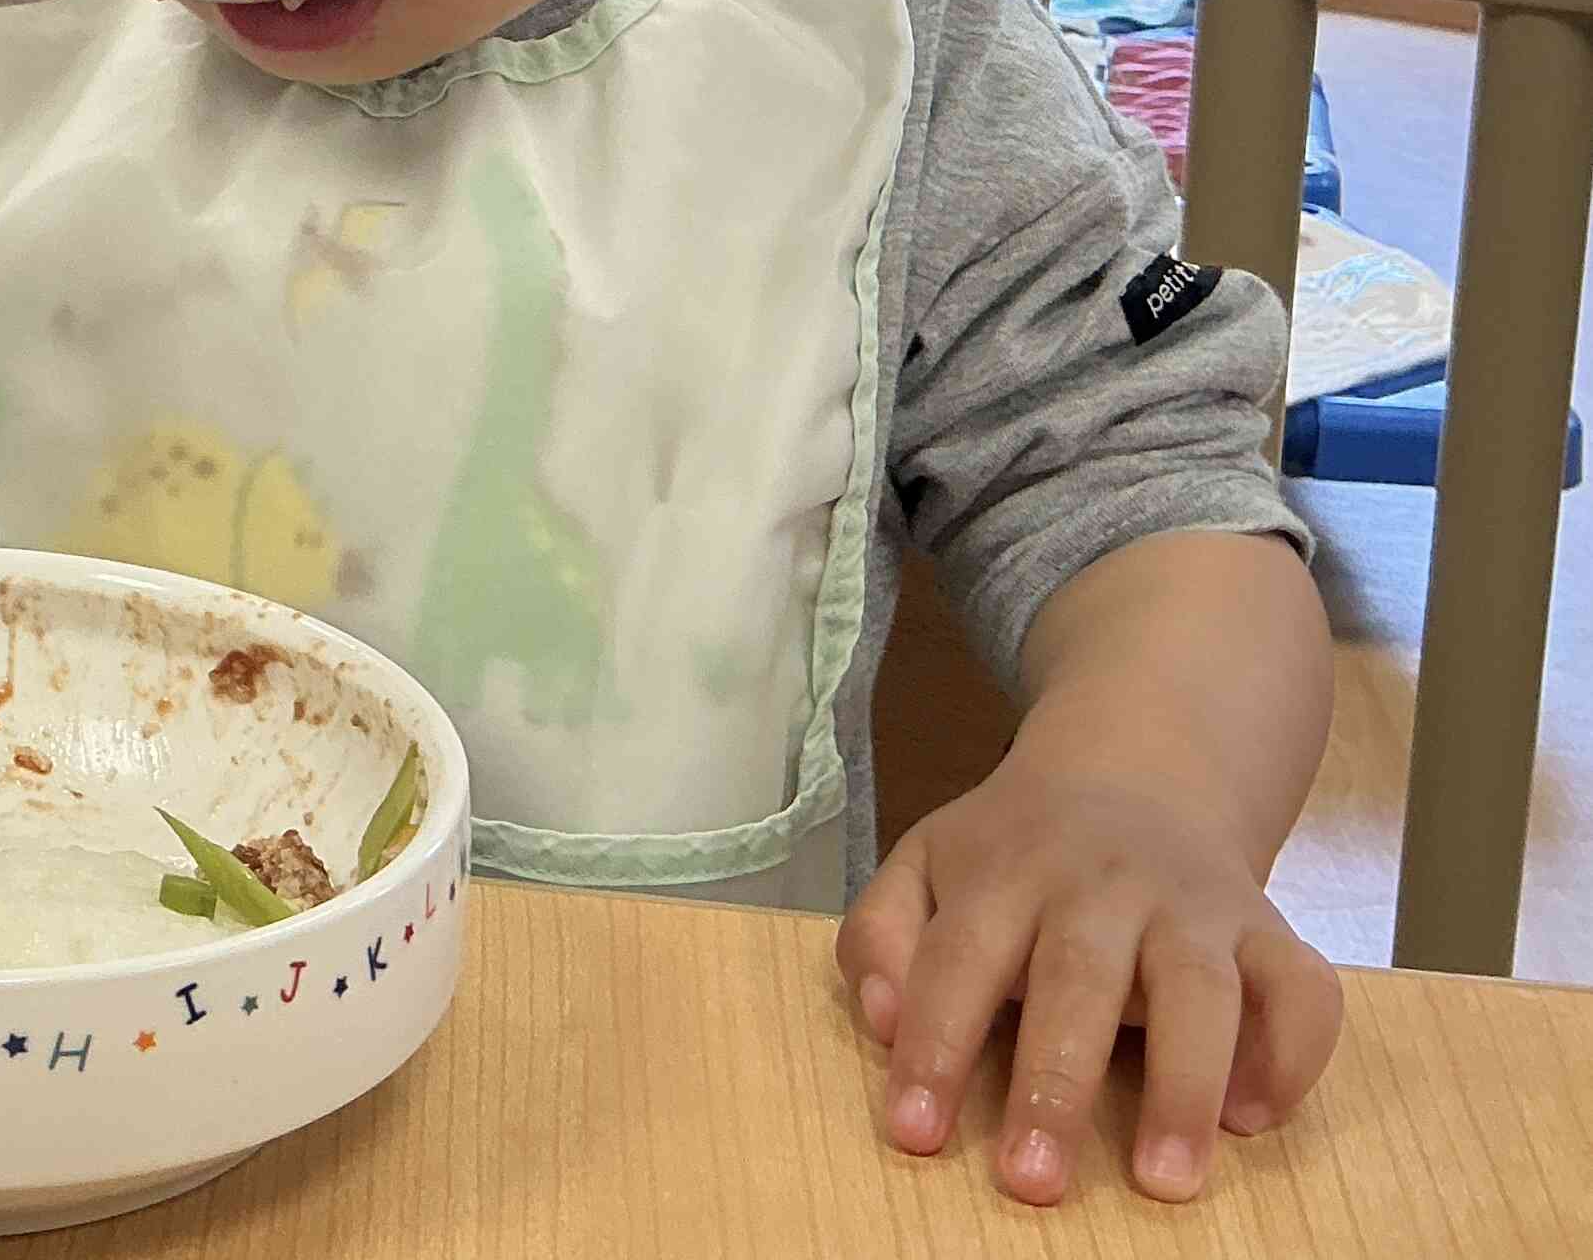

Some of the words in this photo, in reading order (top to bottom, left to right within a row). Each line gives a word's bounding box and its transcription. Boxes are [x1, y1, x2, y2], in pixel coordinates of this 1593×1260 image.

[49, 1031, 93, 1072] H
[175, 982, 207, 1026] I
[280, 961, 307, 1004] J
[368, 936, 388, 982] K
[424, 883, 437, 921] L
